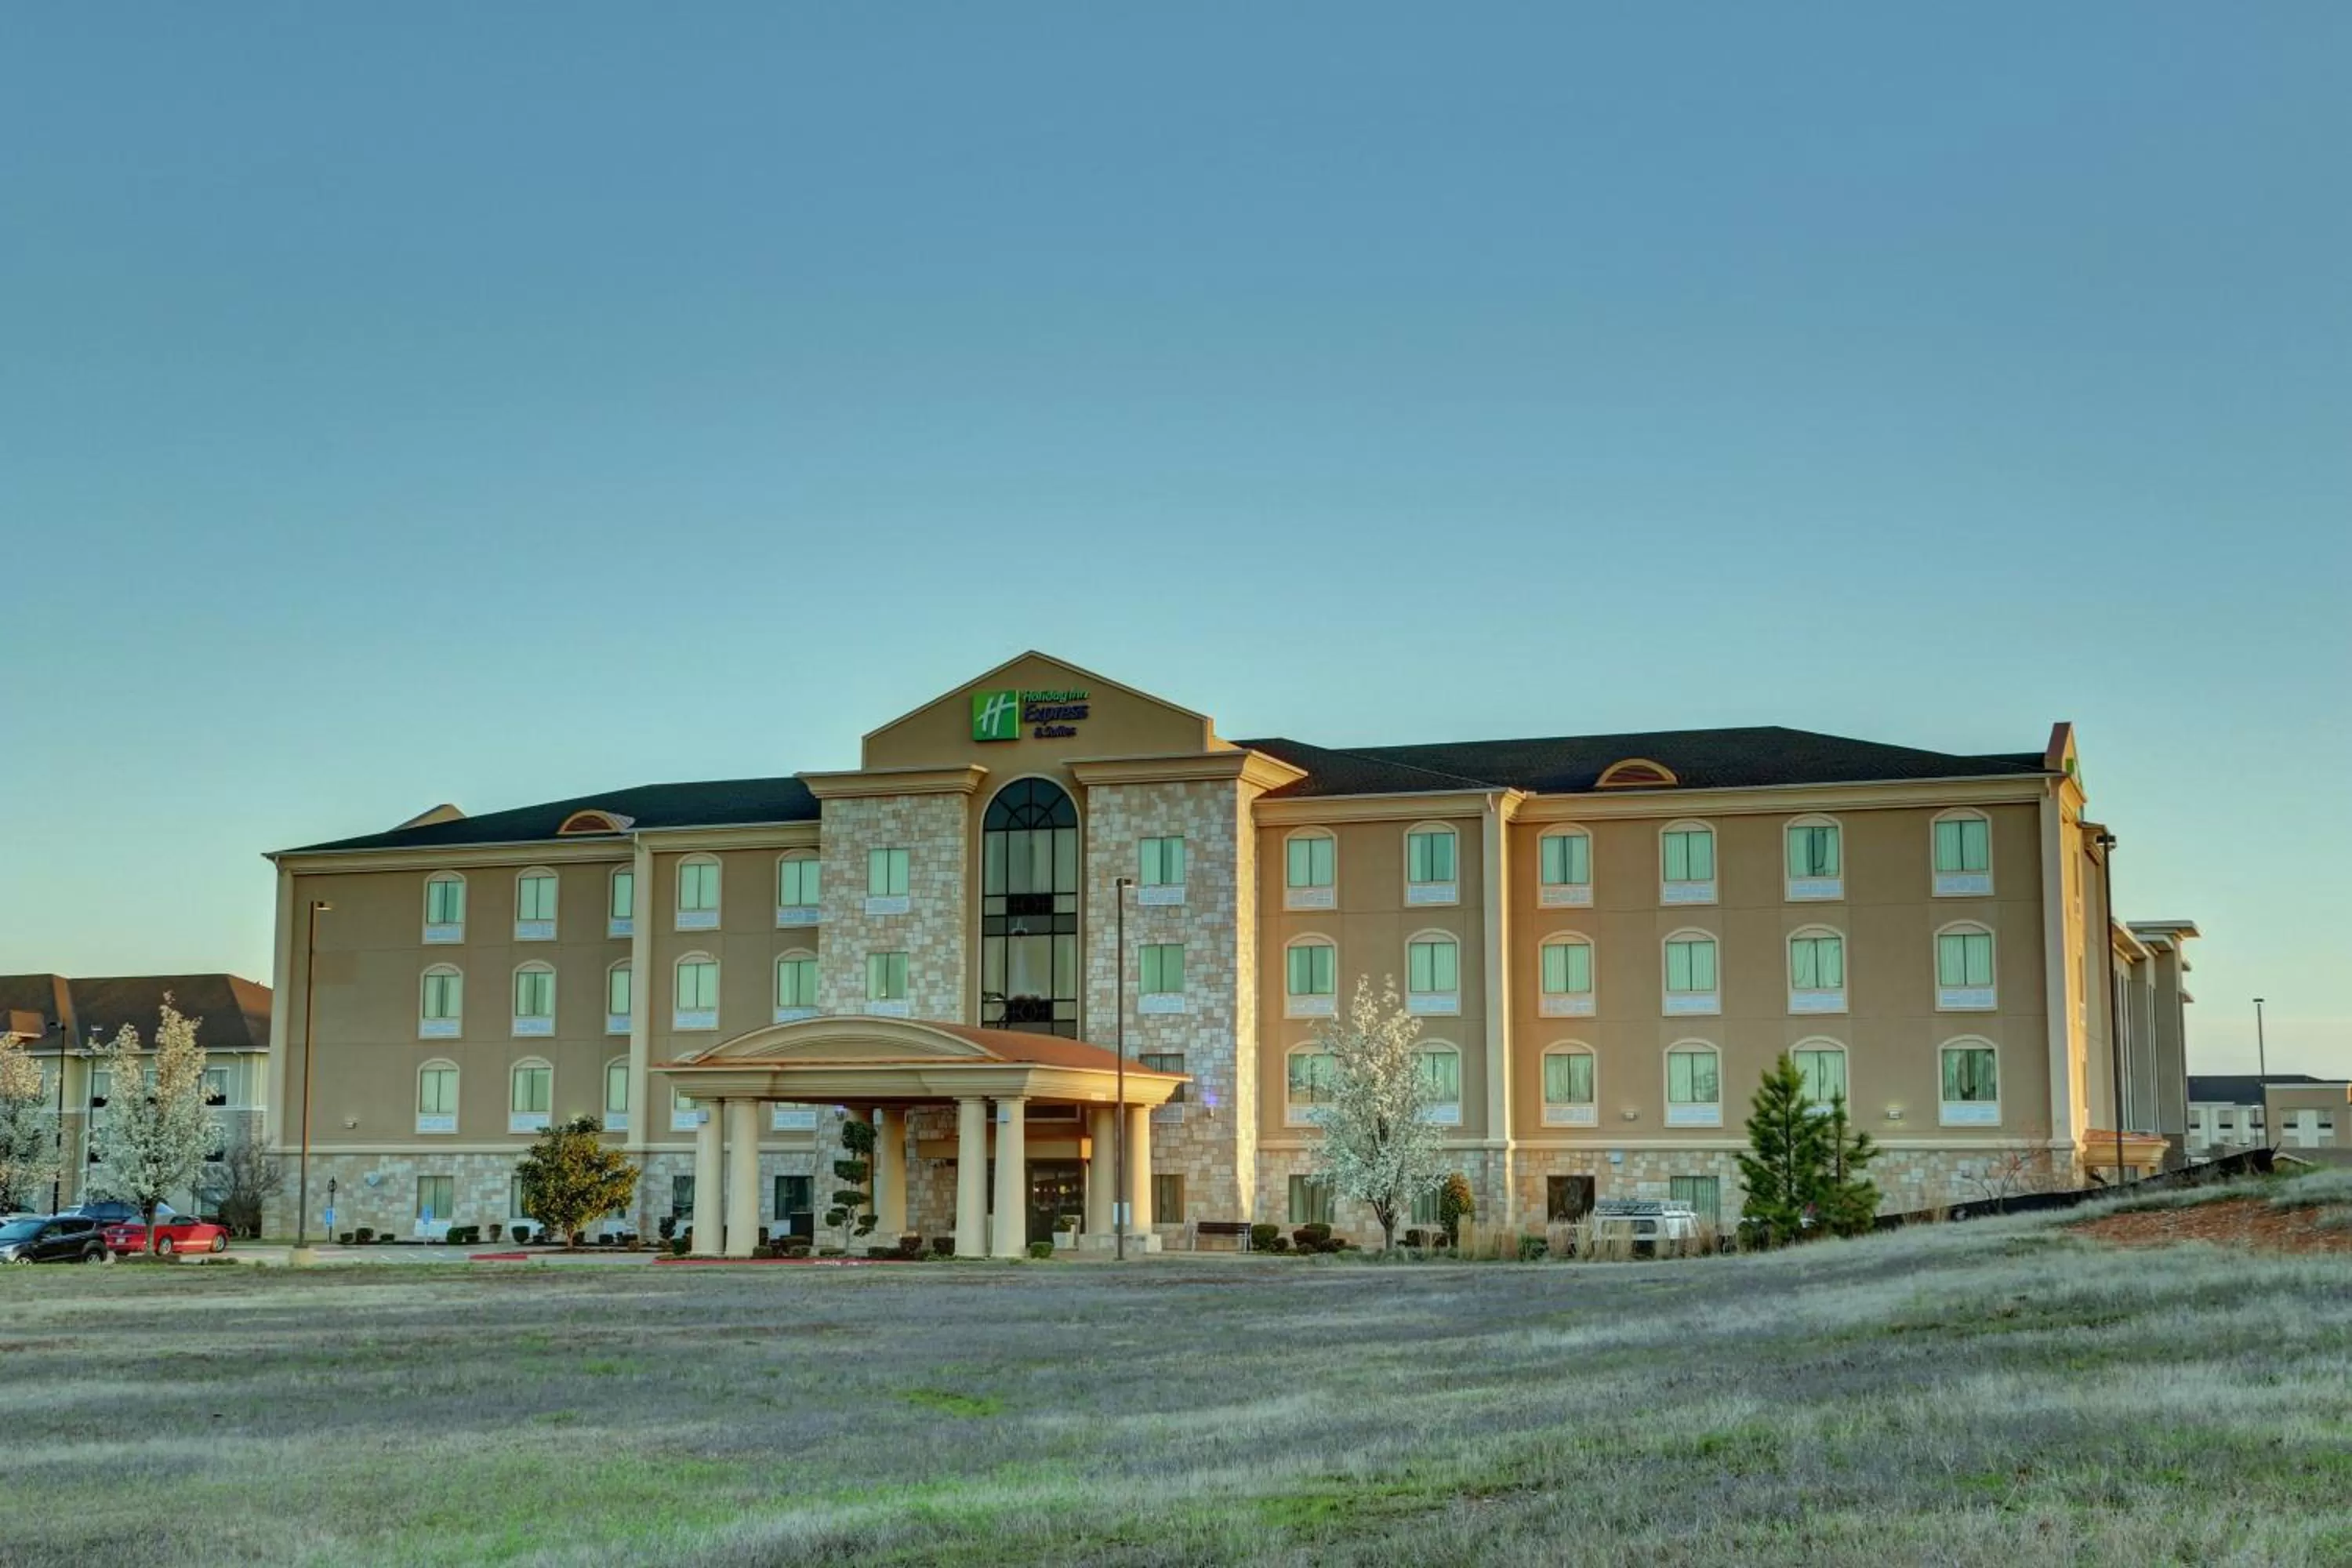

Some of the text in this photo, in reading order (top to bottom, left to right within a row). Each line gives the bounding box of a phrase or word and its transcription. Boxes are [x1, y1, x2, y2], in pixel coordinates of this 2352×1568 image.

[1024, 687, 1089, 703] Holiday Inn
[977, 692, 1018, 736] H
